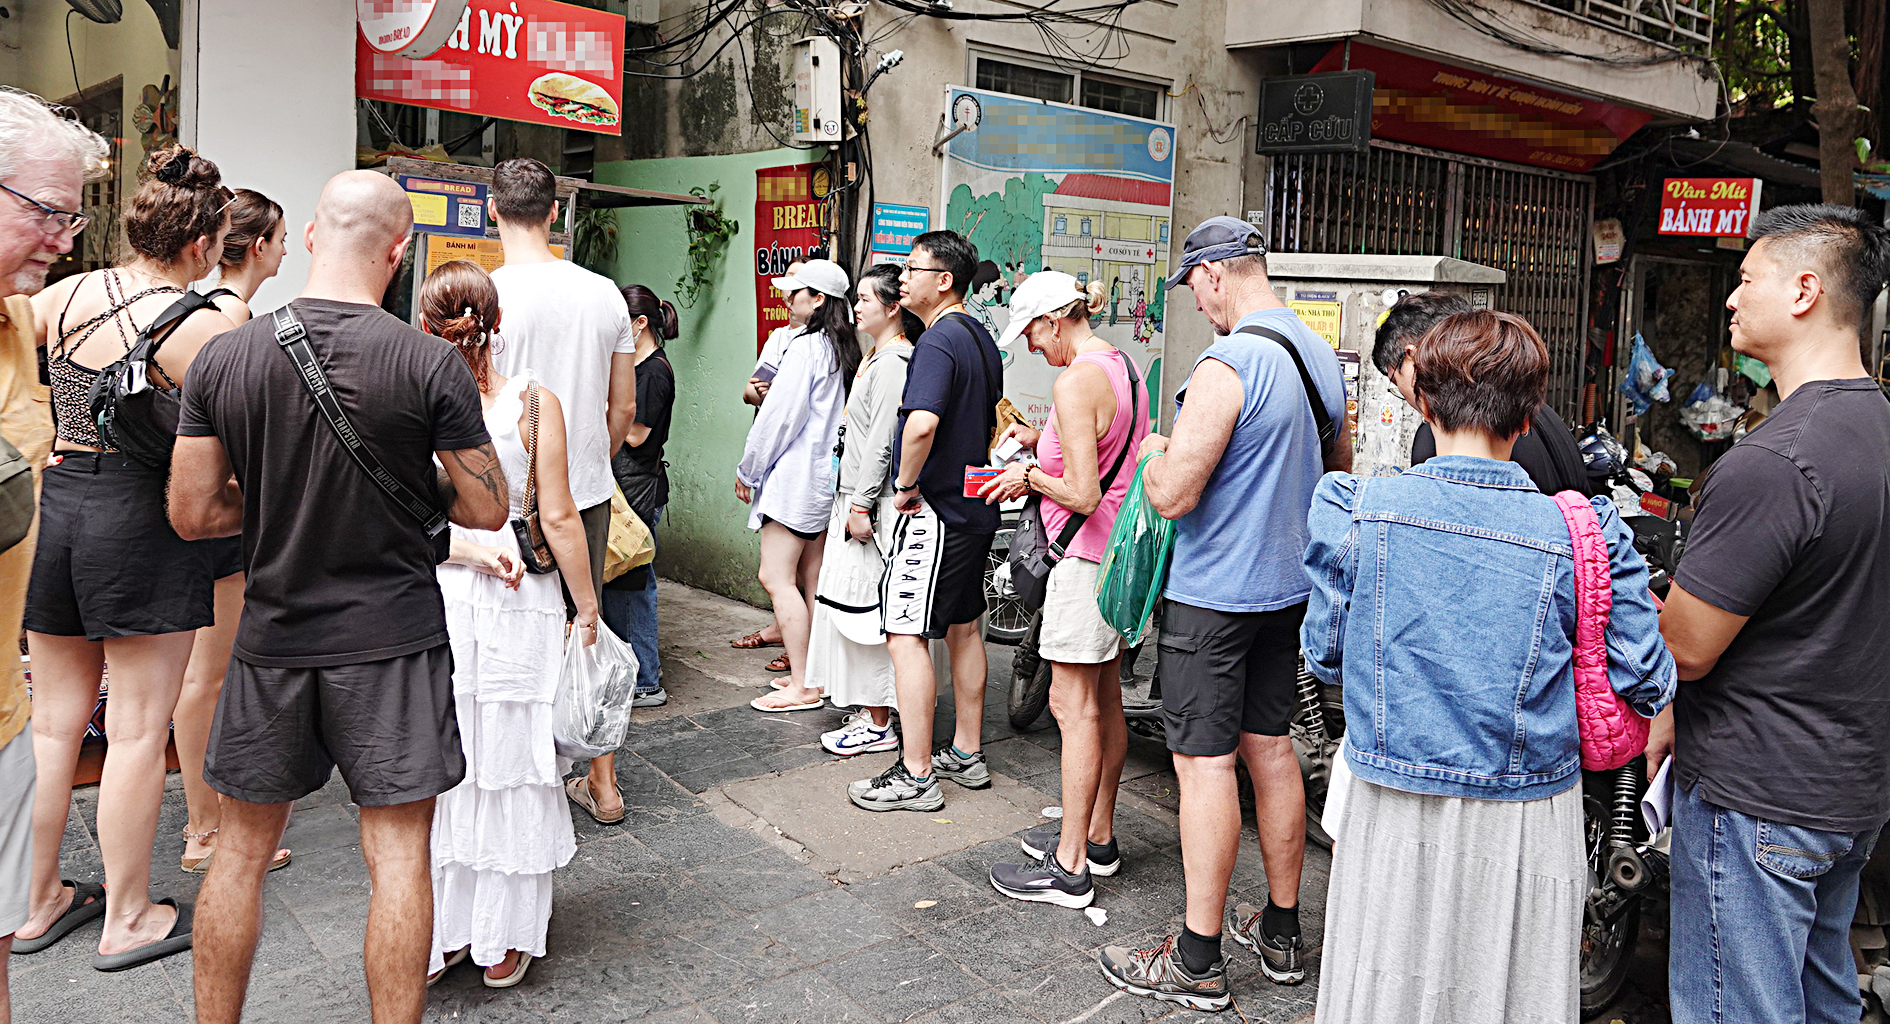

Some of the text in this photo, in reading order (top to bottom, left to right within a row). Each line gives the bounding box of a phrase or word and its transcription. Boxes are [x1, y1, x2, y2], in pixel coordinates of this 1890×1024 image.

[478, 2, 524, 59] MỲ
[1264, 112, 1304, 142] CẤP
[1308, 114, 1353, 141] CỨU
[444, 184, 472, 193] BREAD
[1667, 180, 1707, 199] Vân
[1660, 200, 1748, 234] BÁNH MỲ
[446, 240, 476, 250] BÁNH MÌ
[763, 304, 790, 321] TRỨN
[1308, 308, 1321, 317] NHÀ
[1329, 322, 1334, 331] 9
[303, 361, 327, 396] TRAPSTAR
[1028, 404, 1042, 413] Khi
[334, 416, 361, 450] TRAPSTAR
[372, 466, 400, 493] TRAPSTAR
